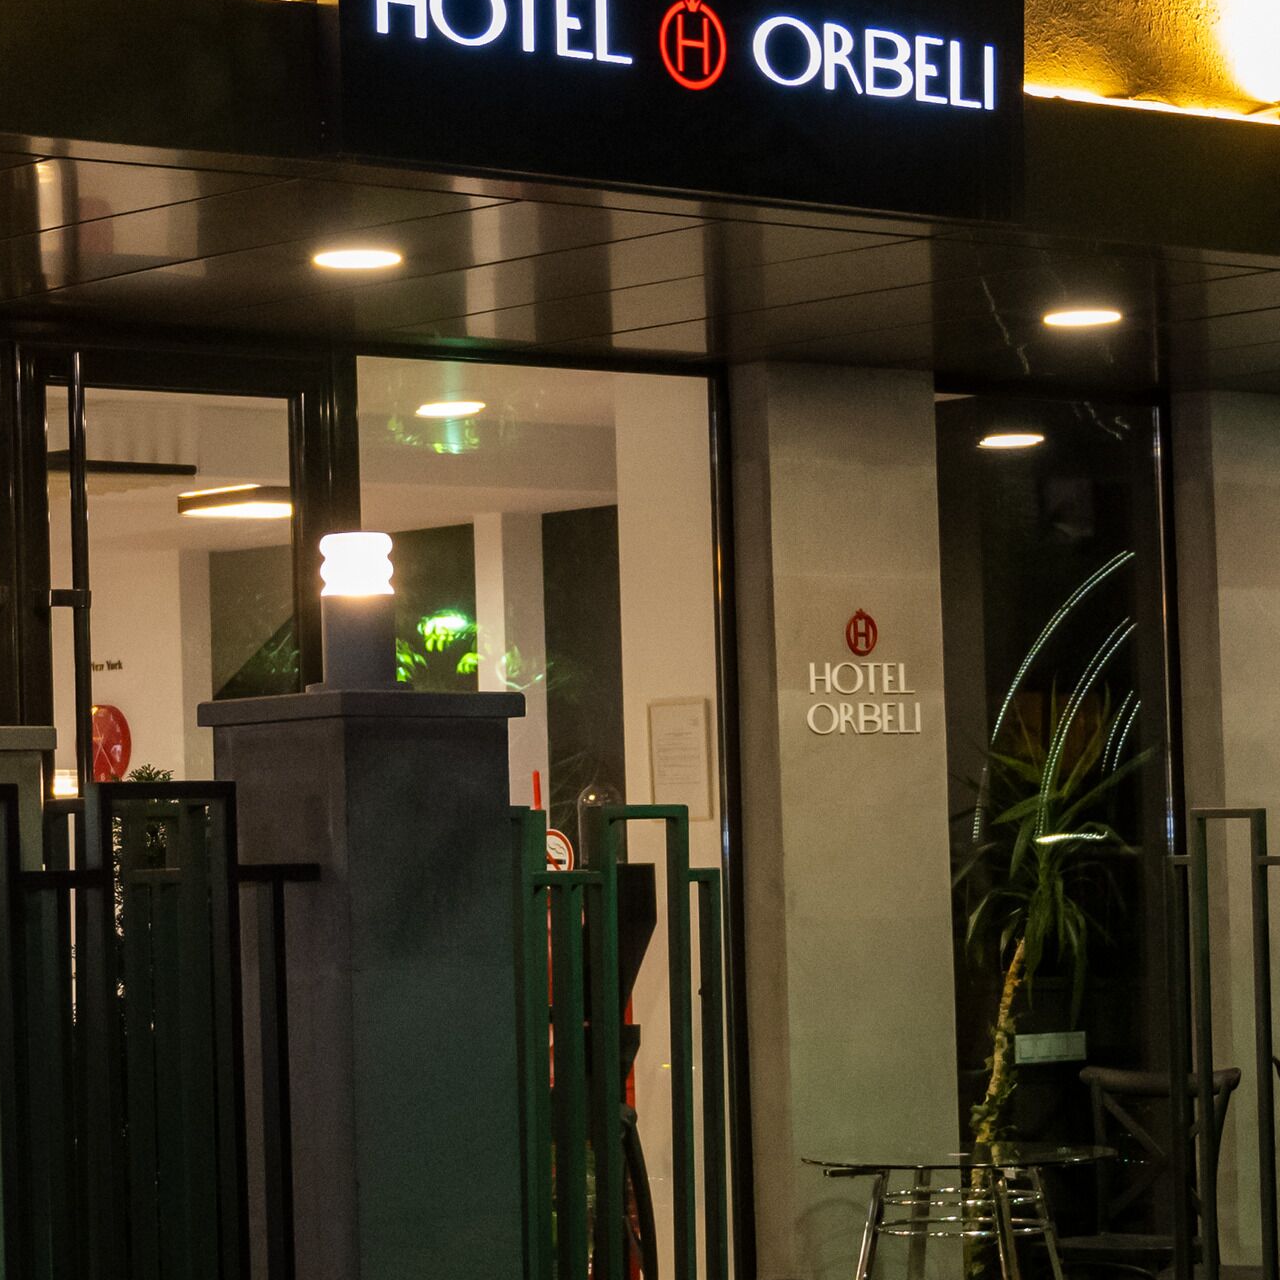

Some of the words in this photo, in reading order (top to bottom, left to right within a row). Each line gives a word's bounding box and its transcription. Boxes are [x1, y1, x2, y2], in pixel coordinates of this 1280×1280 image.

[751, 14, 996, 111] ORBELI
[809, 662, 916, 695] HOTEL
[806, 702, 921, 735] ORBELI
